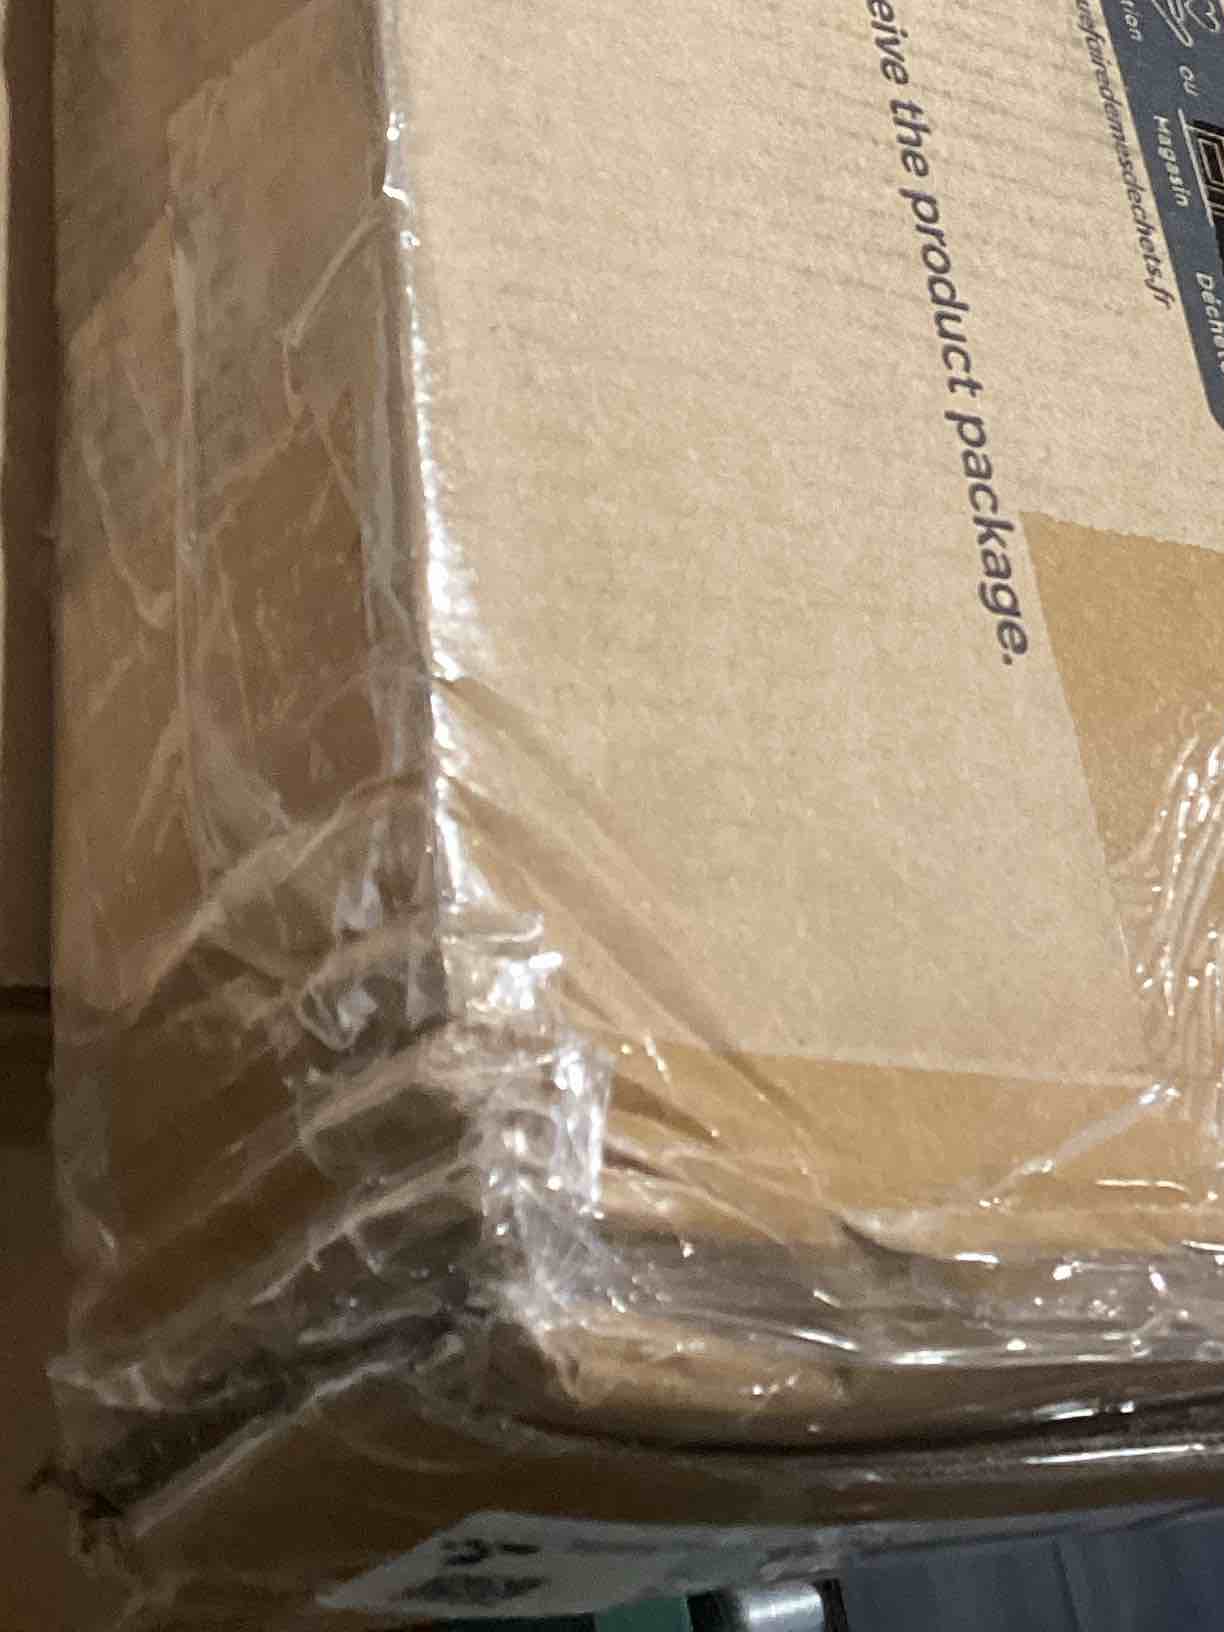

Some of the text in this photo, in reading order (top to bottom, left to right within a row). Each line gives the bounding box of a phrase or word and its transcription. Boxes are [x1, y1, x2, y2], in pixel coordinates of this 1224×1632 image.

[1177, 65, 1197, 96] ou
[887, 98, 936, 177] the
[1152, 115, 1190, 208] Magasin
[898, 188, 982, 397] product
[943, 410, 1030, 666] package.
